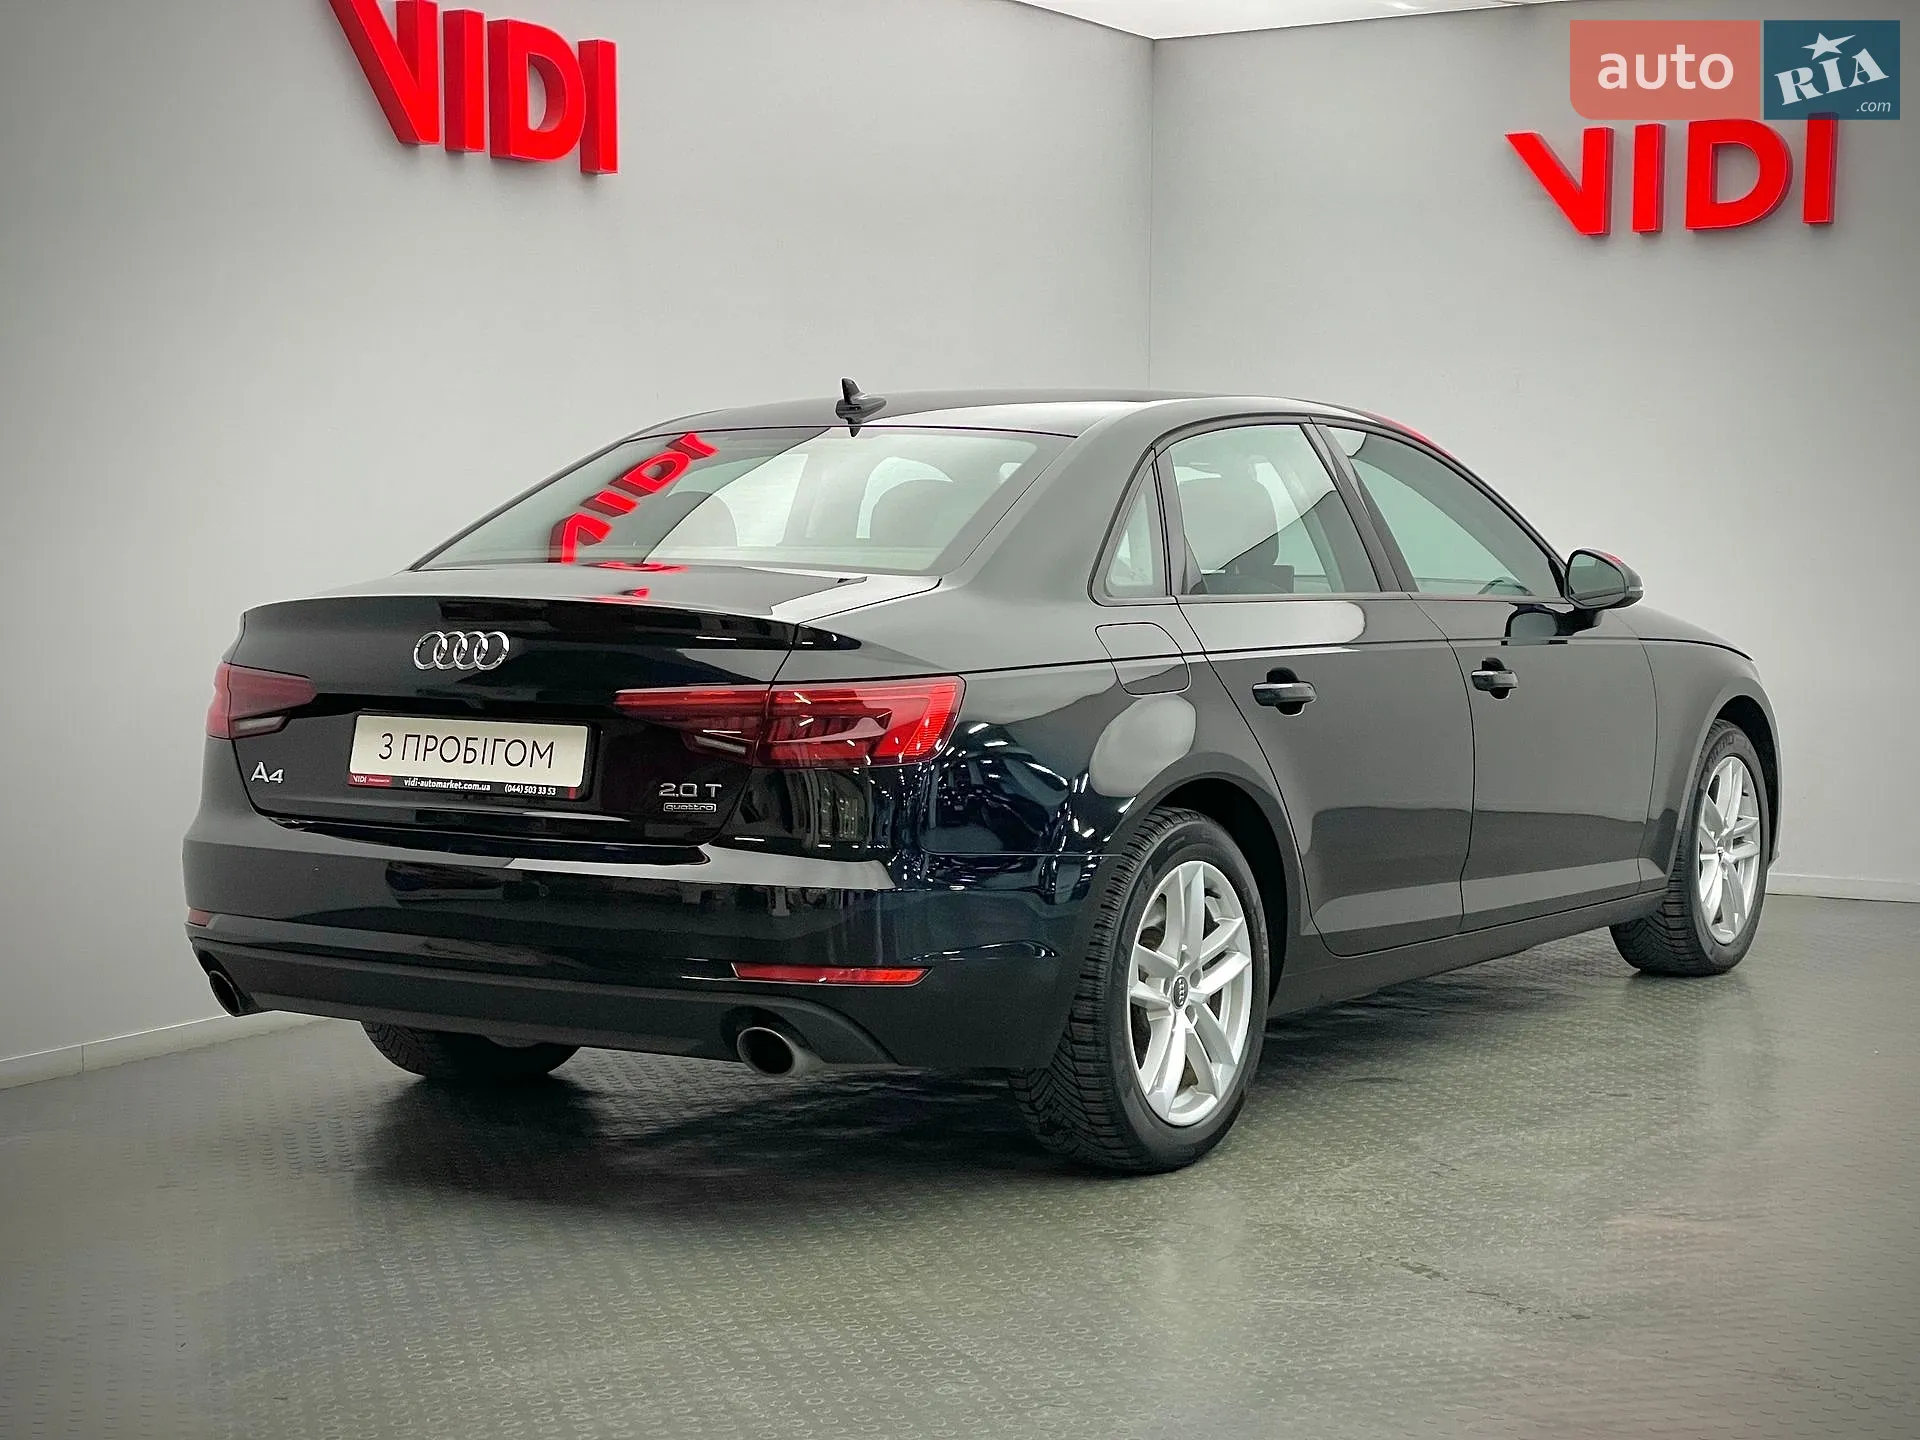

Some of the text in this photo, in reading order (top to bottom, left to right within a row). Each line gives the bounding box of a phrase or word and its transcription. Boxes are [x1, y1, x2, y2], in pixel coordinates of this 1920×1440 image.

[329, 0, 619, 175] VIDI
[1504, 112, 1840, 236] VIDI
[401, 733, 555, 769] ПРОБІГОМ
[250, 760, 285, 784] A4
[353, 775, 367, 784] VIDI
[403, 777, 491, 792] vidi-automarket.com.ua
[504, 783, 557, 796] (044) 503 33 53
[658, 782, 723, 798] 2.0 T
[665, 803, 714, 812] quattro
